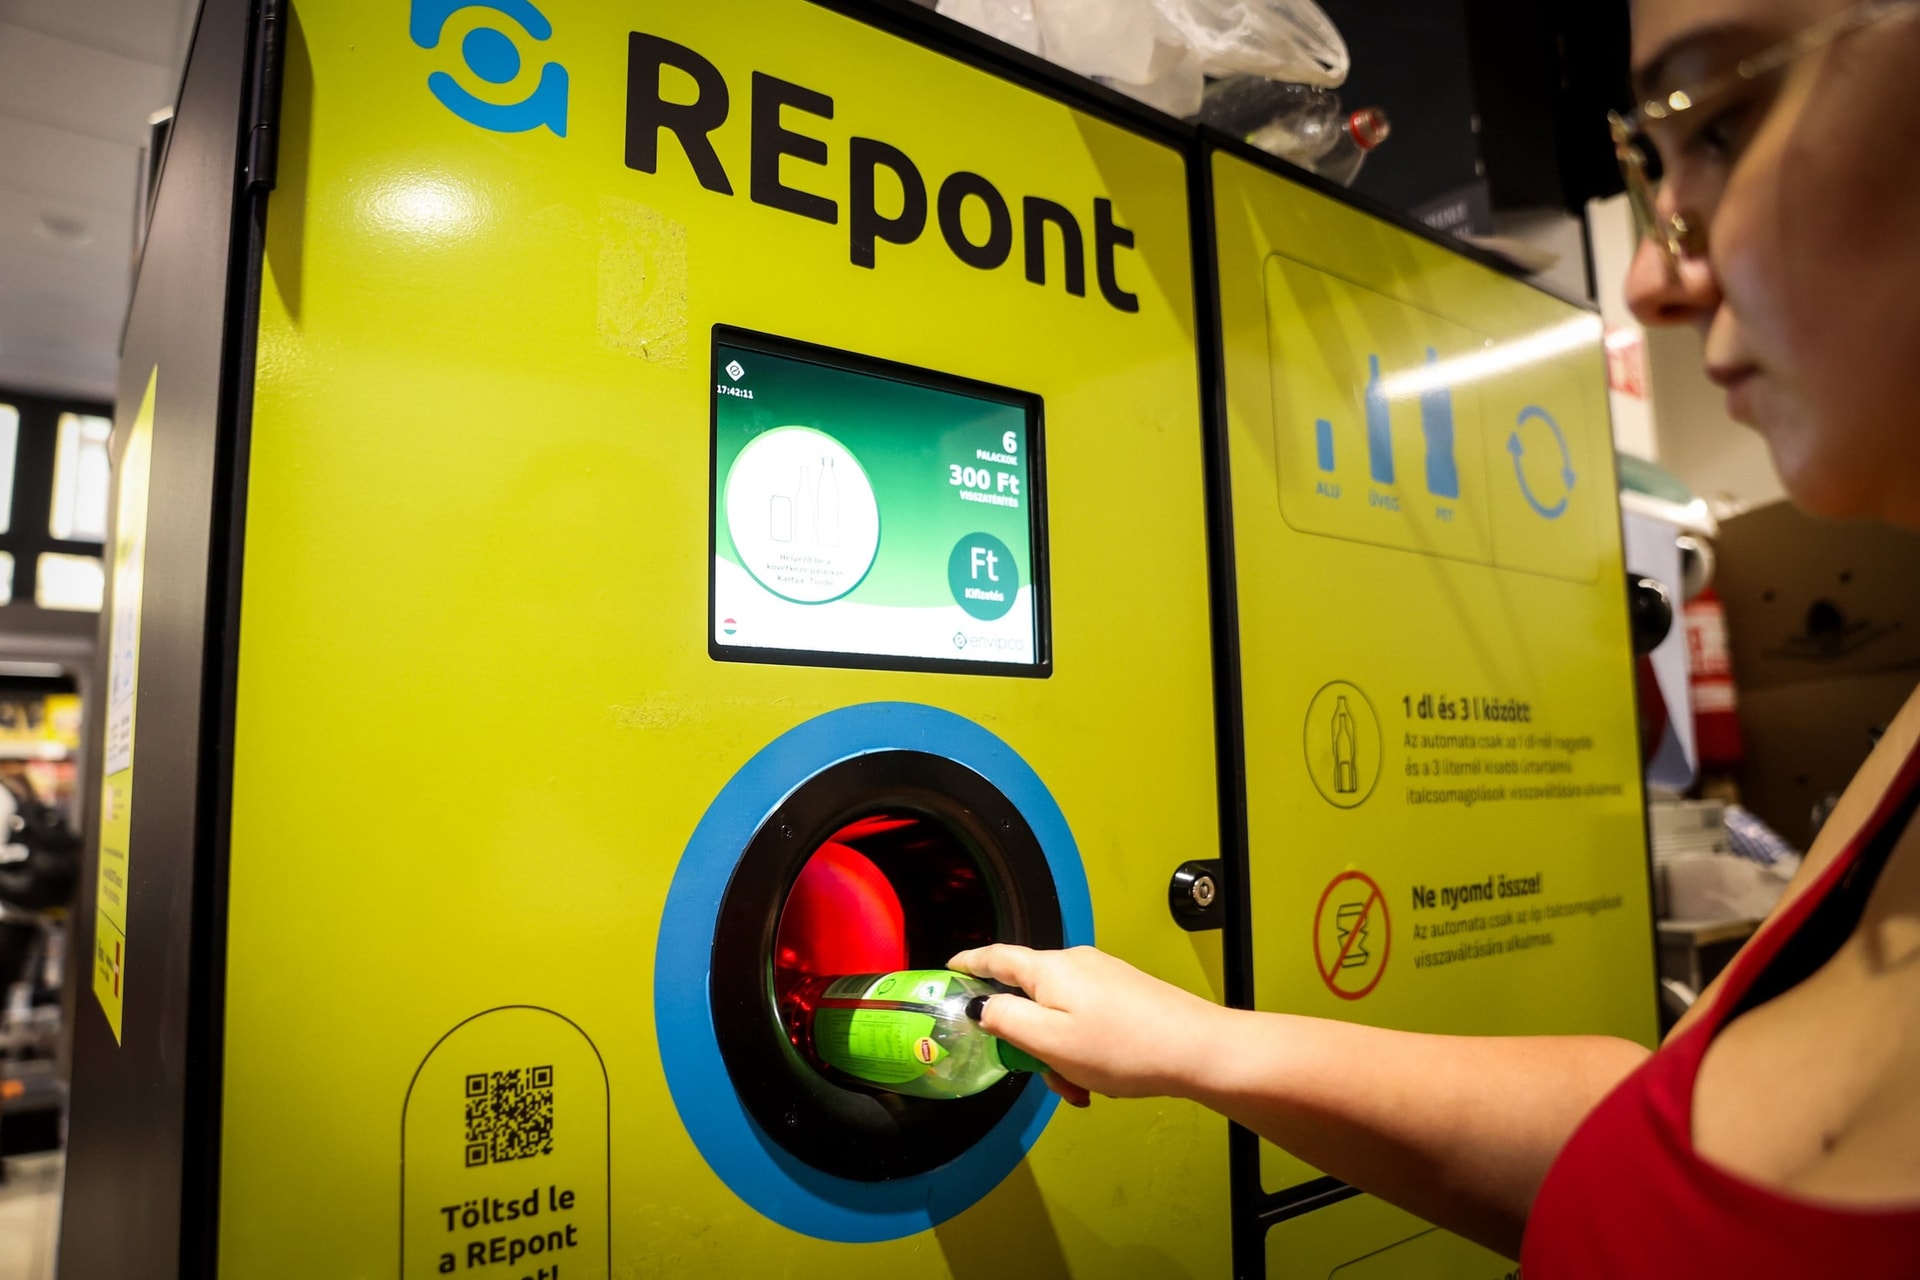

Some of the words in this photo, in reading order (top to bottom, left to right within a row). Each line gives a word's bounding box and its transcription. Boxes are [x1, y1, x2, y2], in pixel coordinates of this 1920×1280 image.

[625, 31, 1139, 313] REpont
[717, 384, 754, 400] 17:42:11
[1002, 431, 1017, 454] 6
[949, 464, 991, 491] 300
[997, 471, 1020, 495] Ft
[1316, 481, 1341, 499] ALU
[970, 547, 999, 581] Ft
[969, 633, 1024, 651] envipco
[1403, 695, 1411, 719] 1
[1416, 694, 1433, 720] dl
[1437, 694, 1456, 720] és
[1459, 697, 1469, 720] 3
[1482, 696, 1531, 722] között
[1404, 731, 1417, 749] Az
[1421, 731, 1476, 749] automata
[1405, 755, 1419, 777] és
[1422, 762, 1429, 776] a
[1432, 759, 1440, 777] 3
[1411, 884, 1436, 911] Ne
[1441, 875, 1493, 911] nyomd
[1497, 870, 1542, 899] össze!
[1413, 923, 1428, 940] Az
[1430, 916, 1486, 938] automata
[1487, 911, 1514, 929] csak
[440, 1187, 540, 1233] Töltsd
[549, 1185, 576, 1212] le
[438, 1252, 457, 1275] a
[466, 1223, 578, 1269] REpont
